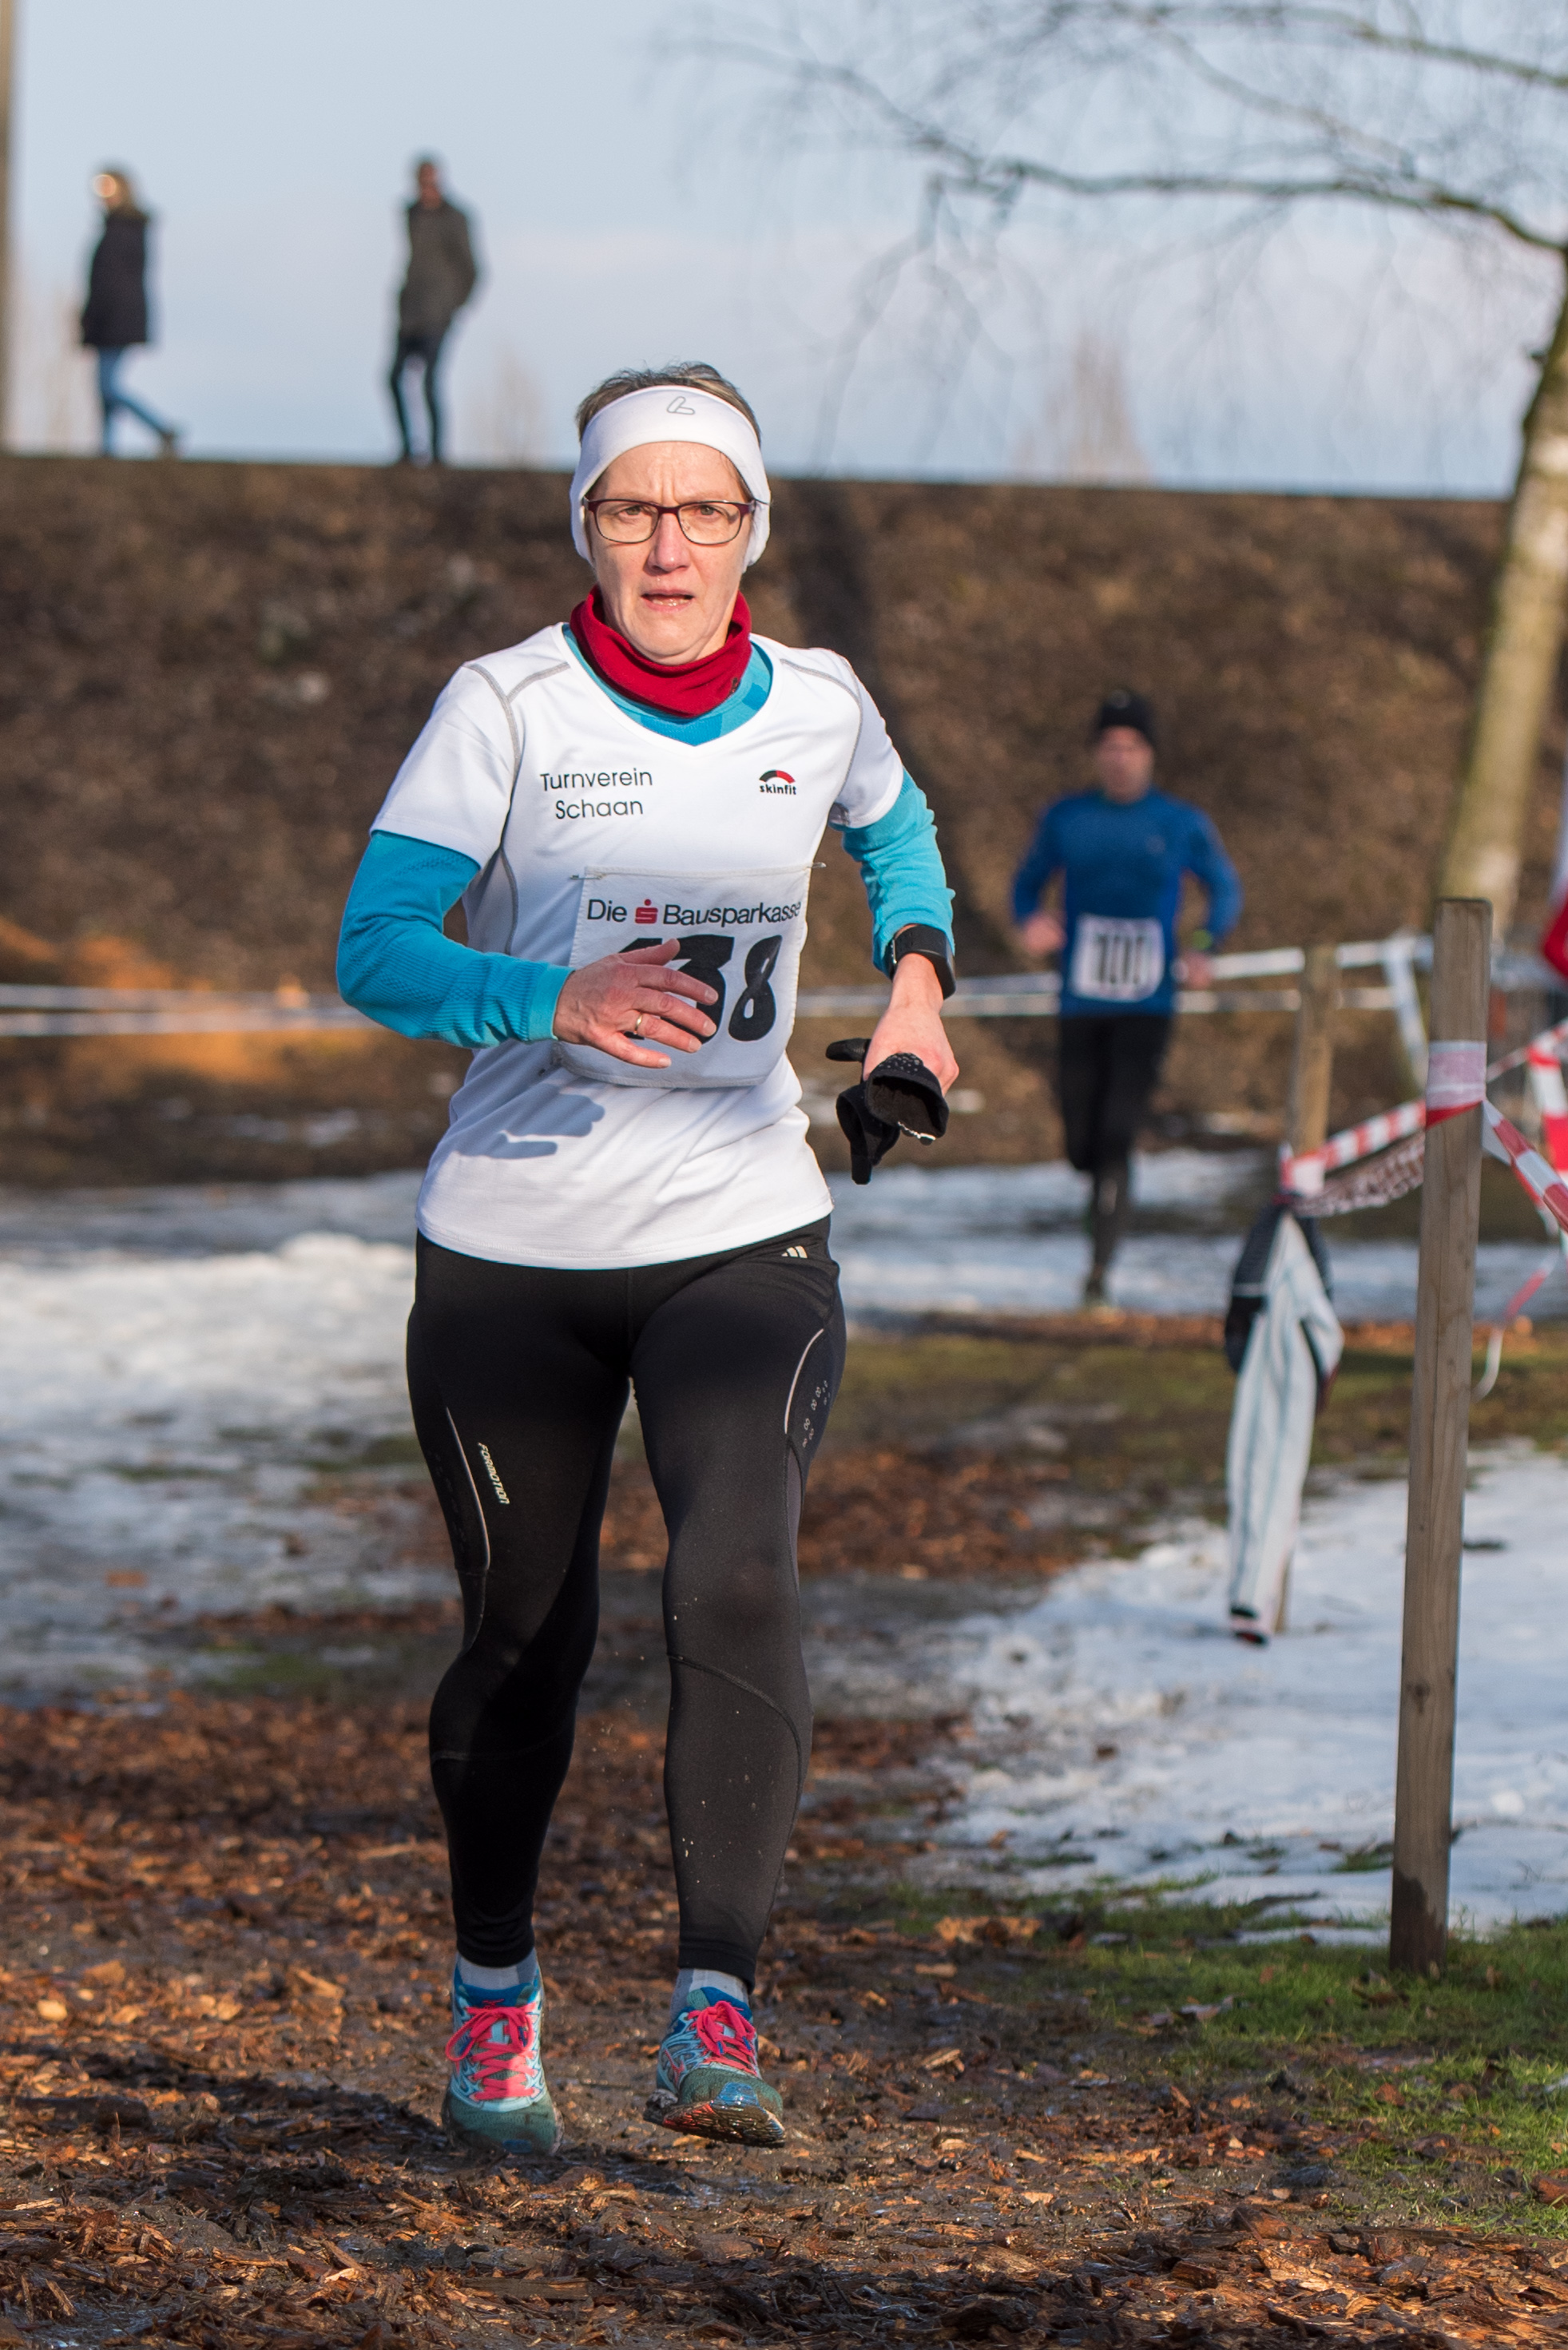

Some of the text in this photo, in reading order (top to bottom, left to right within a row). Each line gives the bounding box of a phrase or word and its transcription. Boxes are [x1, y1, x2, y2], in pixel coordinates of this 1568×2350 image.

[539, 768, 653, 792] Turnverein
[760, 783, 796, 795] skinfit
[555, 799, 643, 820] Schaan
[587, 899, 627, 922] Die
[663, 902, 801, 927] Bausparkasse
